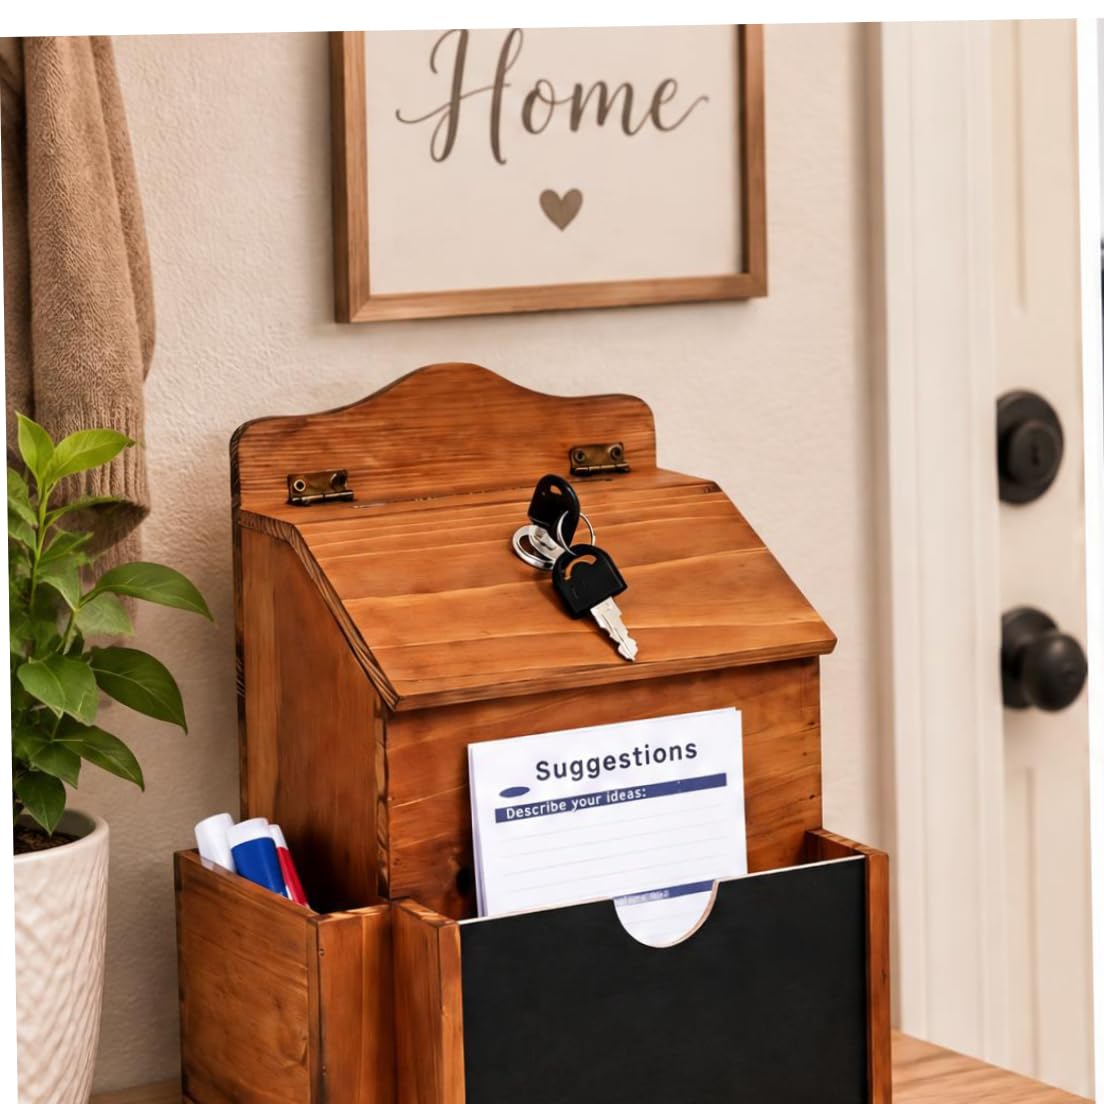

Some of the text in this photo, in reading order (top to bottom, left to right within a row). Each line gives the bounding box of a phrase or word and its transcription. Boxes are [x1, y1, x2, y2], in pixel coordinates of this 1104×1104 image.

[395, 28, 710, 166] Home
[535, 742, 698, 781] Suggestions
[505, 787, 647, 820] Describe your ideas:
